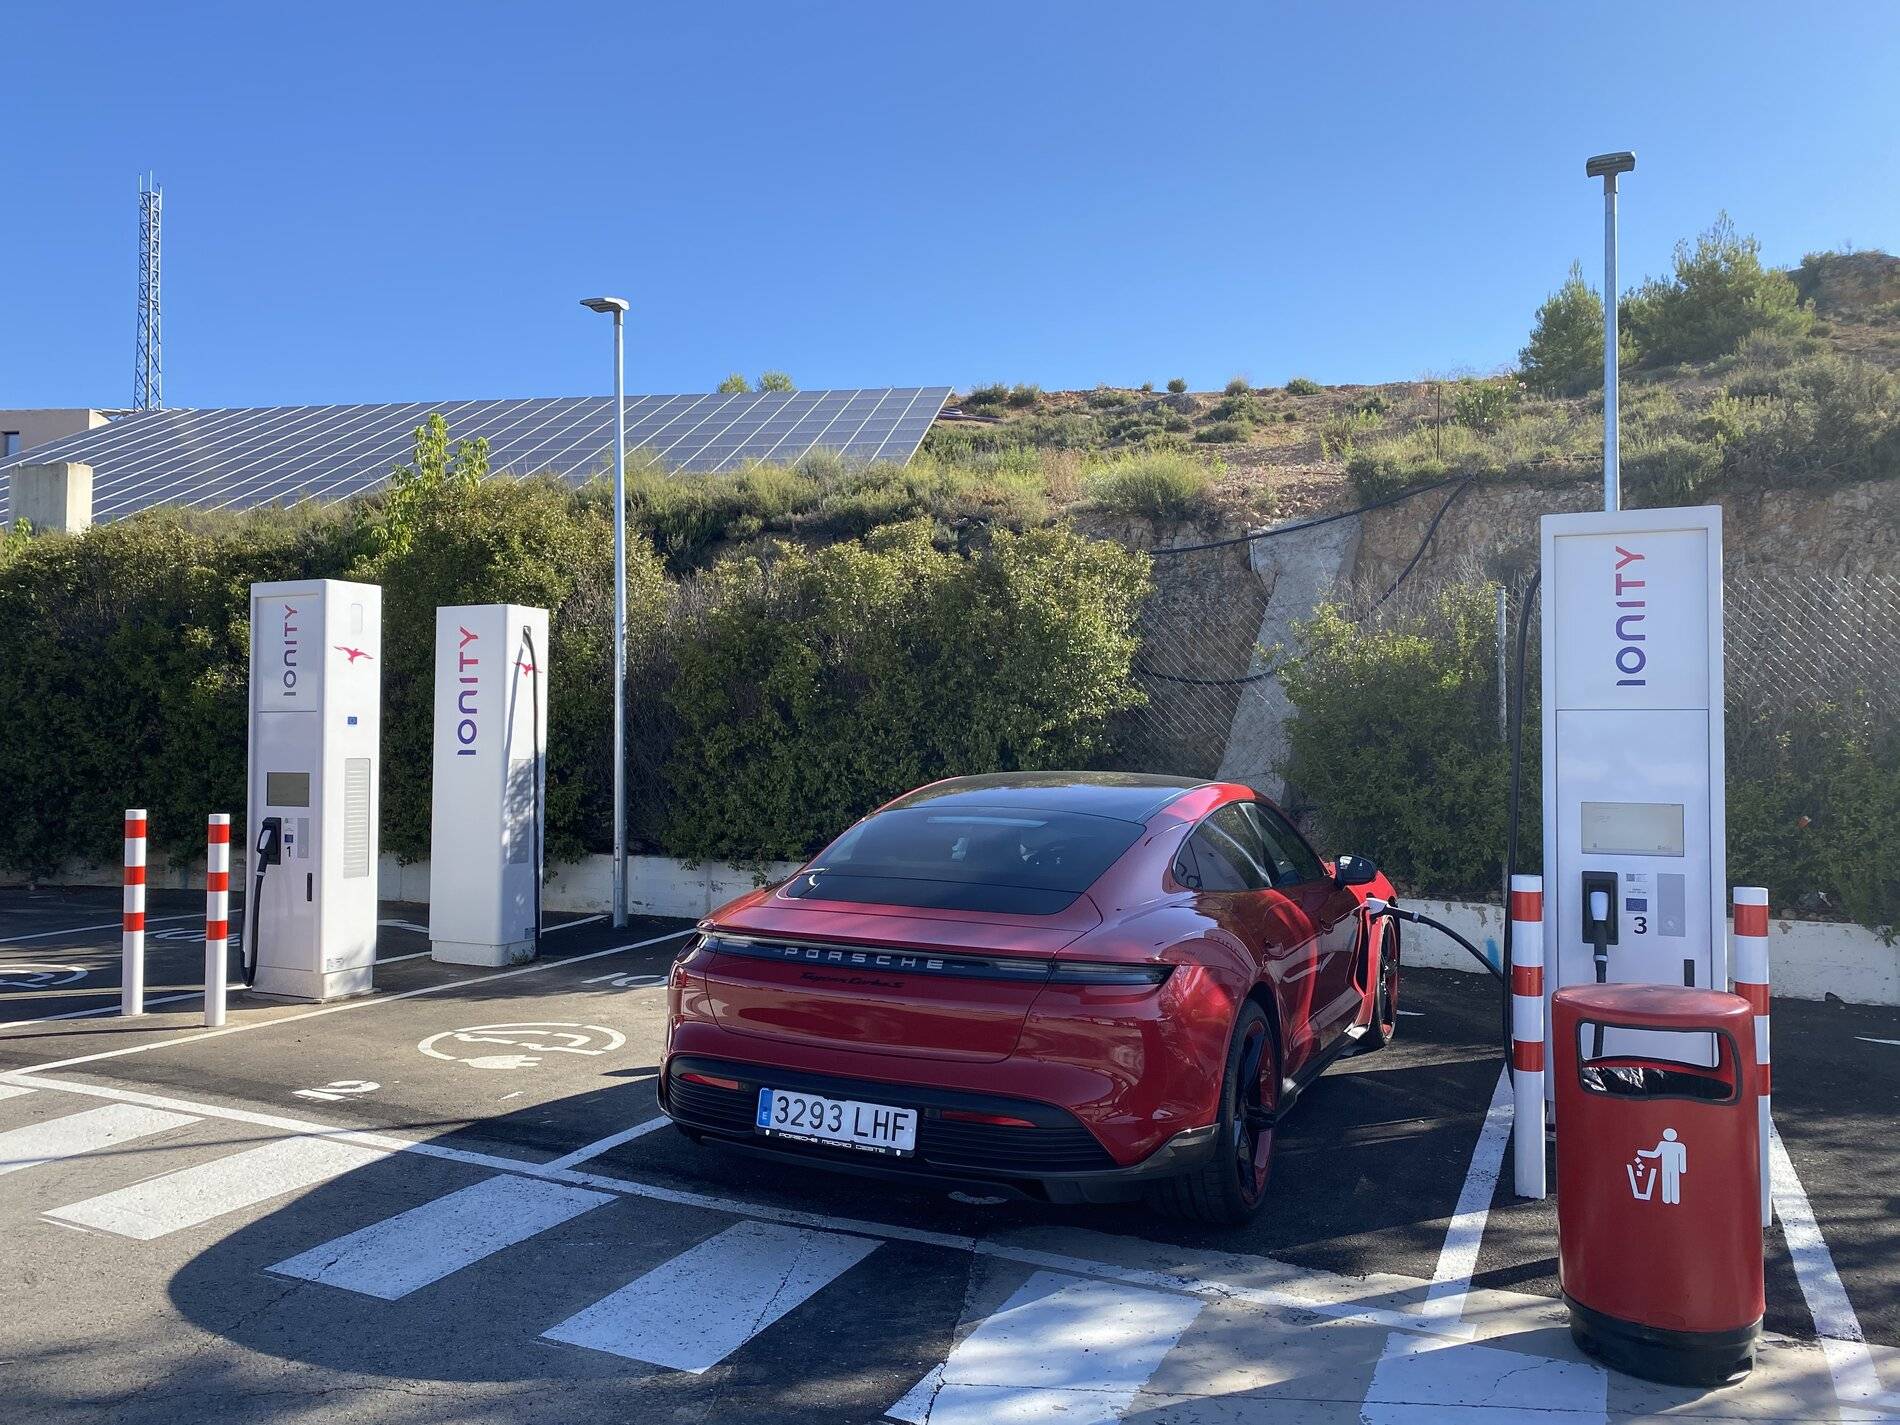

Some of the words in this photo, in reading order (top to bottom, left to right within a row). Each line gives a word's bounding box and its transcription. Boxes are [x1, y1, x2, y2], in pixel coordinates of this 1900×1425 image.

[1615, 545, 1646, 686] IONITY
[282, 604, 298, 697] IONITY
[456, 625, 479, 756] IONITY
[286, 846, 291, 857] 1
[1633, 916, 1648, 935] 3
[784, 947, 944, 970] PORSCHE
[774, 1095, 844, 1134] 3293
[853, 1106, 910, 1142] LHF
[778, 1132, 819, 1144] PORSCHE
